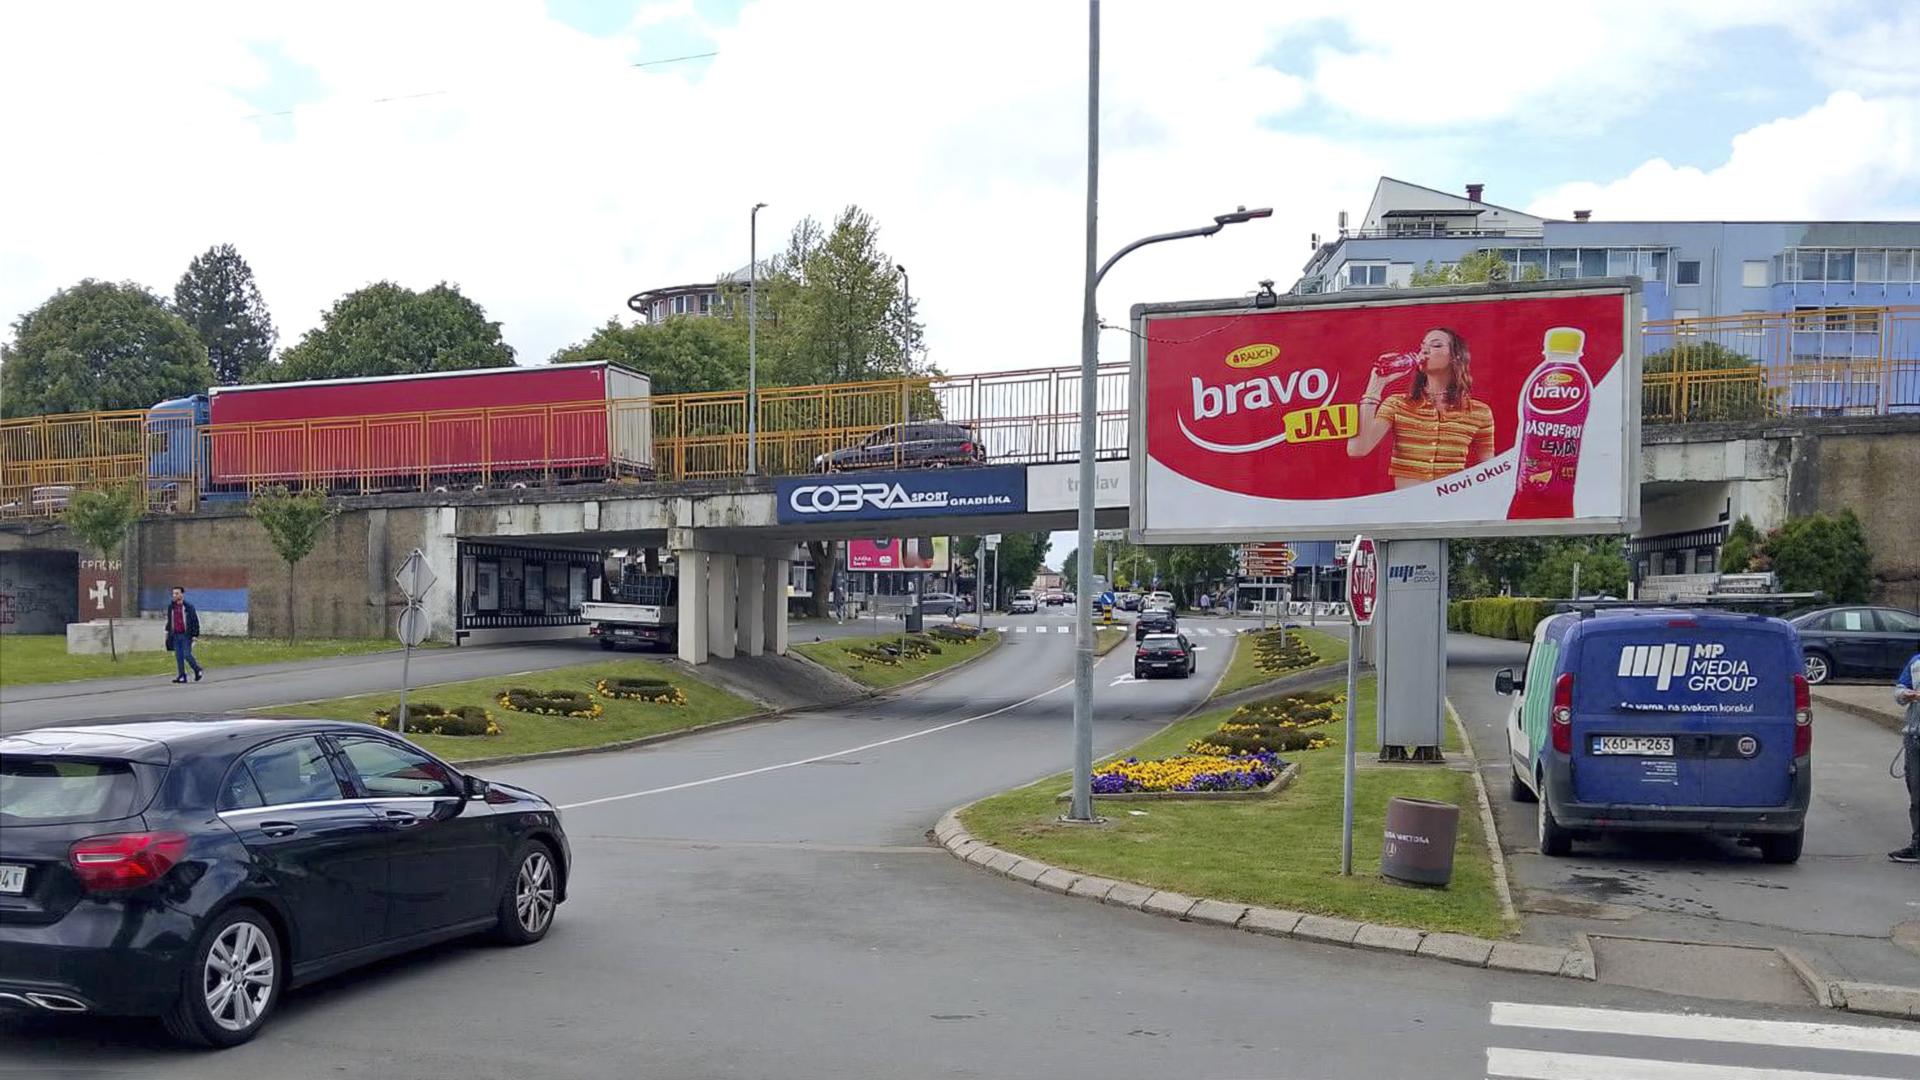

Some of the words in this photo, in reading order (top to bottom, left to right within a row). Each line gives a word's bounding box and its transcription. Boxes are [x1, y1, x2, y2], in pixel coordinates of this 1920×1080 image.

[1241, 347, 1273, 362] RAUCH
[1191, 368, 1329, 421] bravo
[1533, 382, 1580, 400] bravo
[1295, 407, 1347, 439] JA!
[1540, 439, 1578, 457] LEMON
[1067, 475, 1120, 492] trlav
[1436, 474, 1473, 497] Novi
[1475, 460, 1512, 483] okus
[790, 481, 912, 513] COBRA
[911, 491, 949, 502] SPORT
[949, 495, 1012, 506] GRADIŠKA
[1353, 567, 1375, 595] STOP
[1693, 643, 1725, 659] MP
[1691, 660, 1749, 675] MEDIA
[1688, 676, 1758, 692] GROUP
[1668, 704, 1680, 712] na
[1681, 703, 1718, 712] svakom
[1602, 737, 1671, 751] K60-T-263
